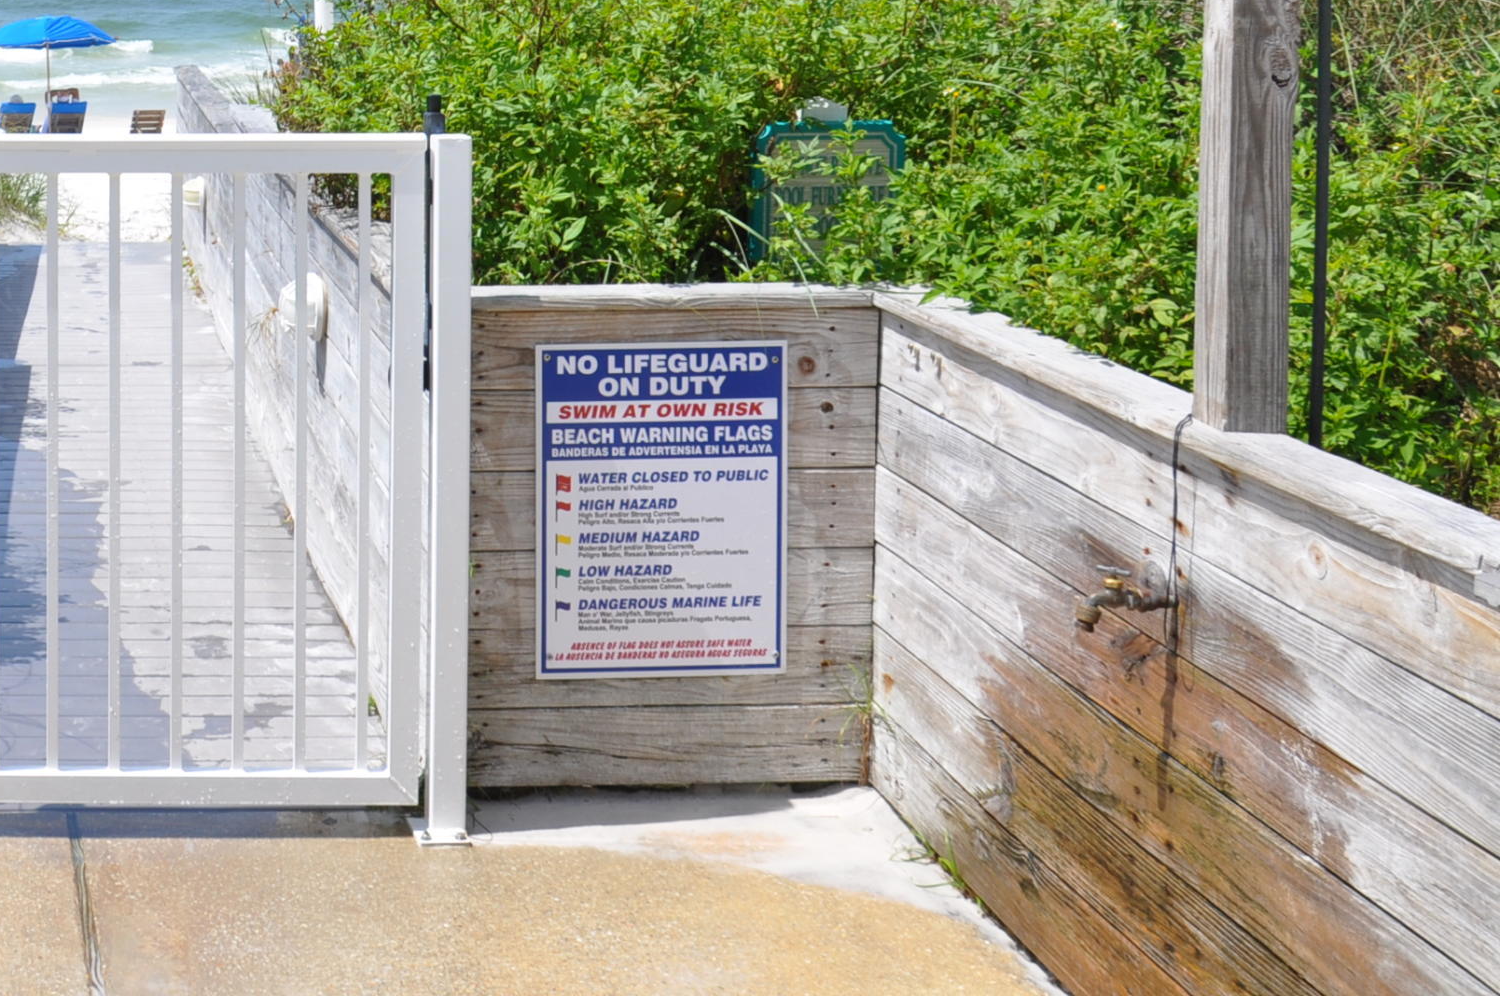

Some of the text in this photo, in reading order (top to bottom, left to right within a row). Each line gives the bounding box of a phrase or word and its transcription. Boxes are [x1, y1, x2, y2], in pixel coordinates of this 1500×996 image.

[557, 353, 768, 375] NO LIFEGUARD
[598, 376, 726, 397] ON DUTY
[558, 402, 764, 419] SWIM AT OWN RISK
[552, 425, 773, 444] BEACH WARNING FLAGS
[552, 444, 773, 458] BANDERAS DE ADVERTENSIA EN LA PLAYA
[577, 472, 628, 484] WATER
[631, 471, 689, 483] CLOSED
[693, 470, 712, 482] TO
[715, 469, 770, 481] PUBLIC
[578, 498, 678, 510] HIGH HAZARD
[577, 531, 701, 544] MEDIUM HAZARD
[577, 565, 673, 577] LOW HAZARD
[577, 596, 762, 610] DANGEROUS MARINE LIFE
[570, 639, 753, 650] ABSENCE OF FLAG DOES NOT ASSURE SAFE WATER
[554, 652, 564, 661] LA
[566, 652, 603, 660] AUSENCIA
[605, 652, 615, 660] DE
[617, 651, 657, 659] BANDERAS
[671, 650, 706, 658] ASEGURA
[707, 649, 732, 657] AGUAS
[733, 649, 768, 657] SEGURAS
